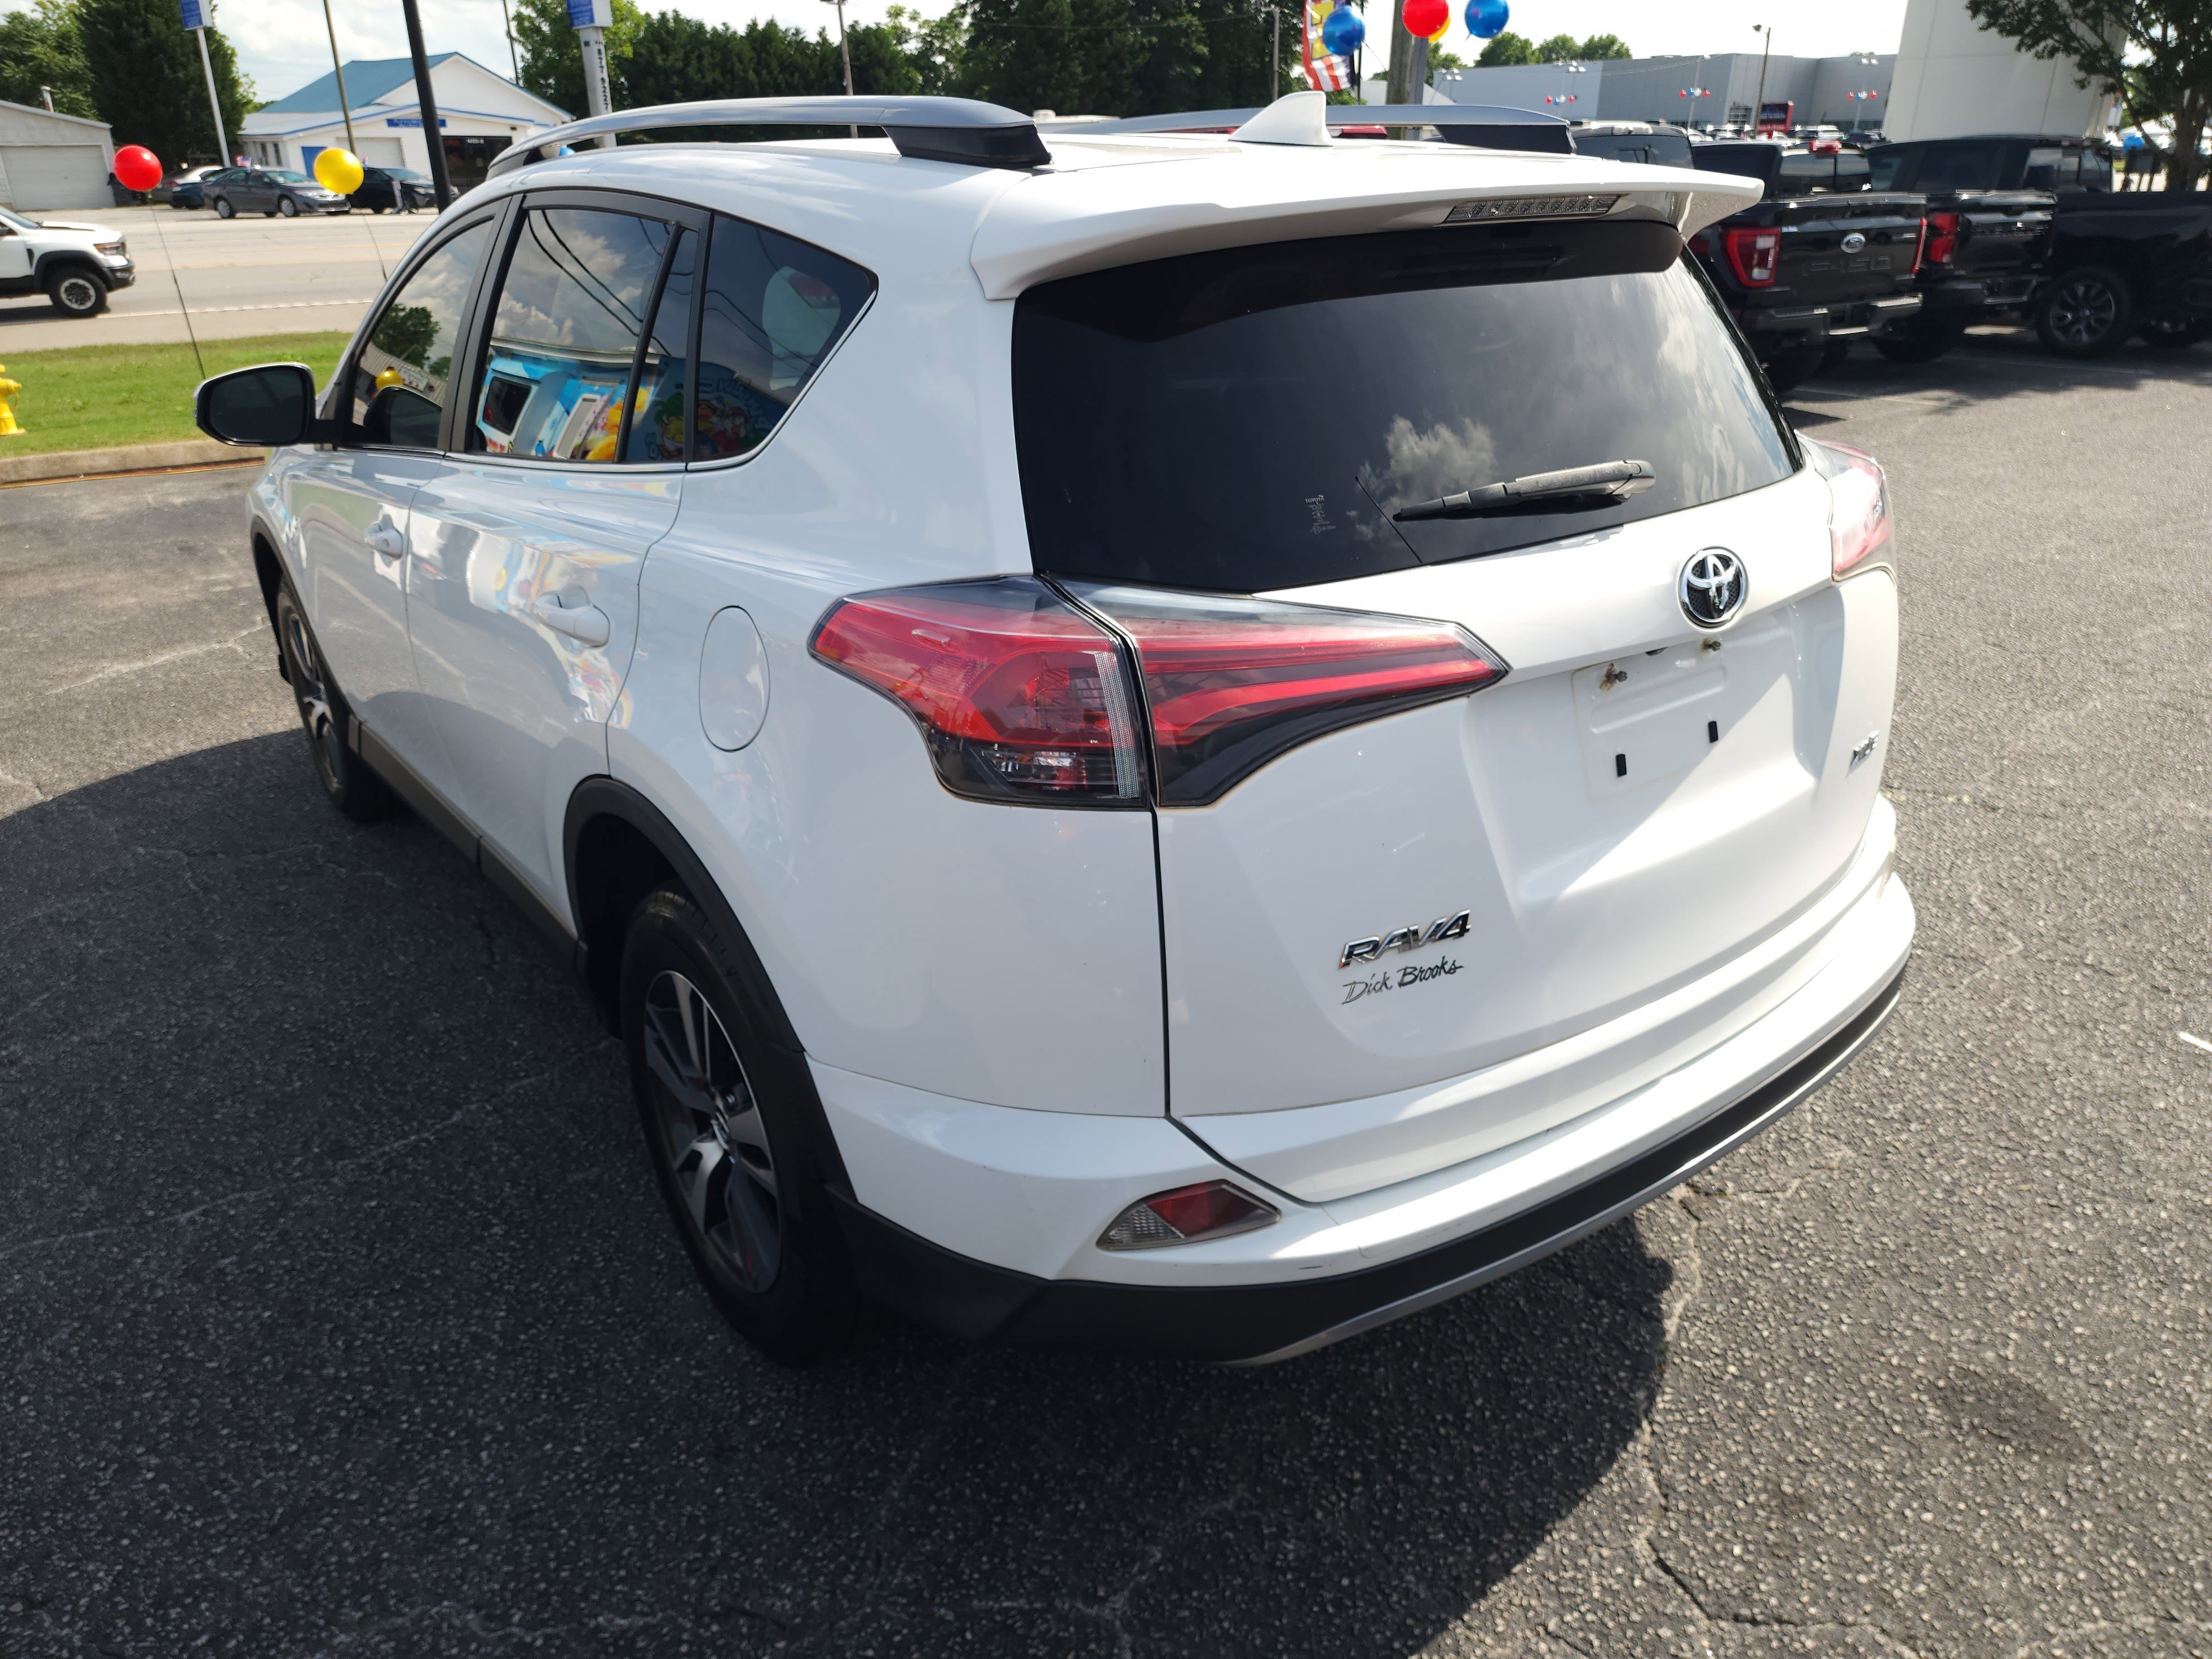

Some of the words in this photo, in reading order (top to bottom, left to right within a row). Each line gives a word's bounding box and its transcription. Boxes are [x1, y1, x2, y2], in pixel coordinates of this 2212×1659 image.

[1338, 910, 1472, 970] RAV4
[1341, 972, 1393, 1005] Dick
[1396, 956, 1464, 988] Brooks
